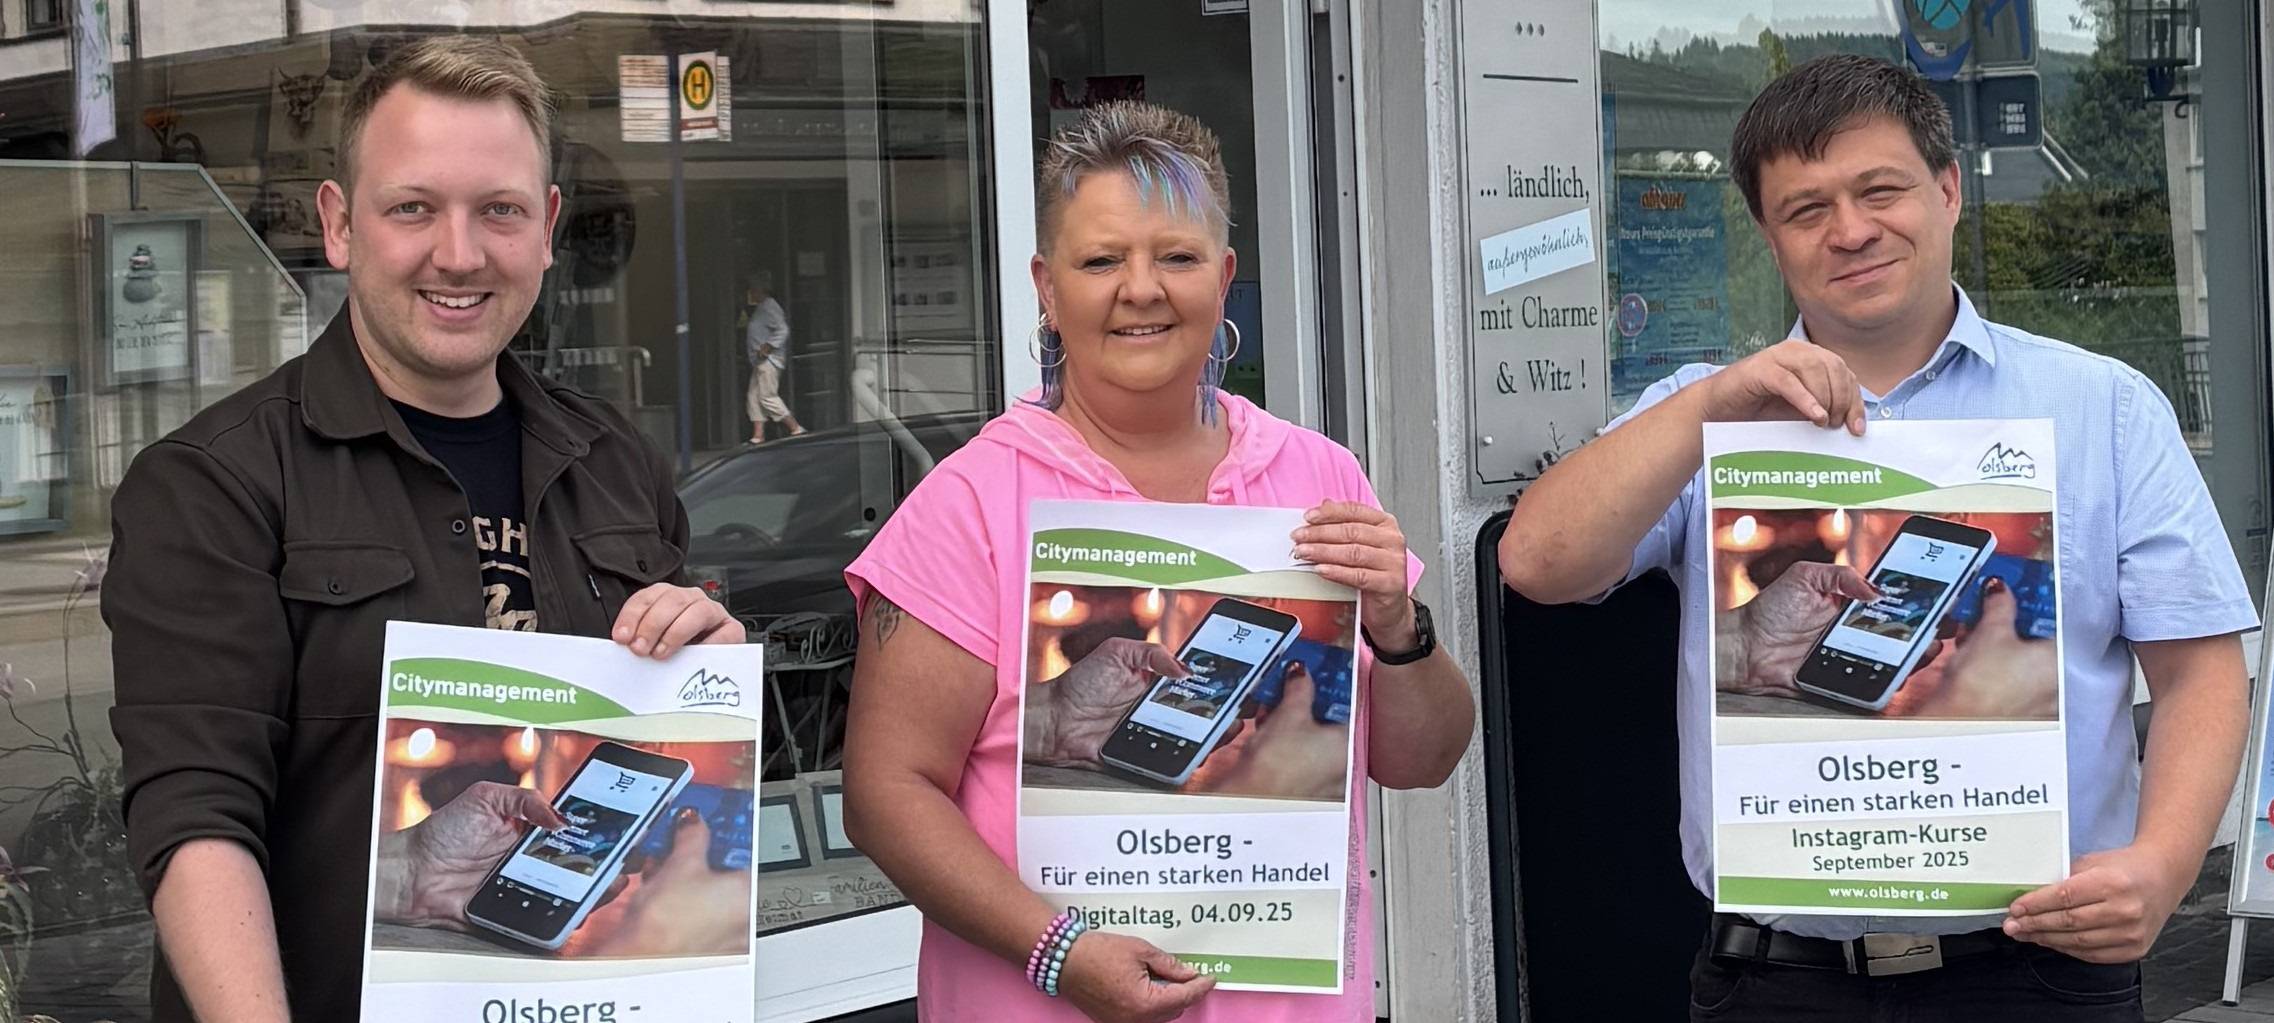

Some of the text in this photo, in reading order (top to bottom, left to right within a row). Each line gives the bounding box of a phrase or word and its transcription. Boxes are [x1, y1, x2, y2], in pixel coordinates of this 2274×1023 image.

[1507, 164, 1590, 204] ländlich,
[1480, 298, 1513, 331] mit
[1521, 295, 1598, 329] Charme
[1496, 360, 1518, 395] &
[1526, 359, 1572, 393] Witz
[1713, 466, 1883, 489] Citymanagement
[1981, 459, 2035, 479] olsberg
[1035, 542, 1197, 567] Citymanagement
[392, 672, 577, 705] Citymanagement
[682, 688, 741, 708] olsberg
[1818, 754, 1939, 785] Olsberg
[1740, 784, 2049, 816] Für einen starken Handel
[1116, 828, 1232, 860] Olsberg
[1792, 824, 1988, 851] Instagram-Kurse
[1041, 862, 1330, 886] Für einen starken Handel
[1813, 850, 1970, 874] September 2025
[1828, 886, 1949, 902] www.olsberg.de
[1067, 901, 1293, 930] Digitaltag, 04.09.25
[482, 998, 617, 1023] Olsberg
